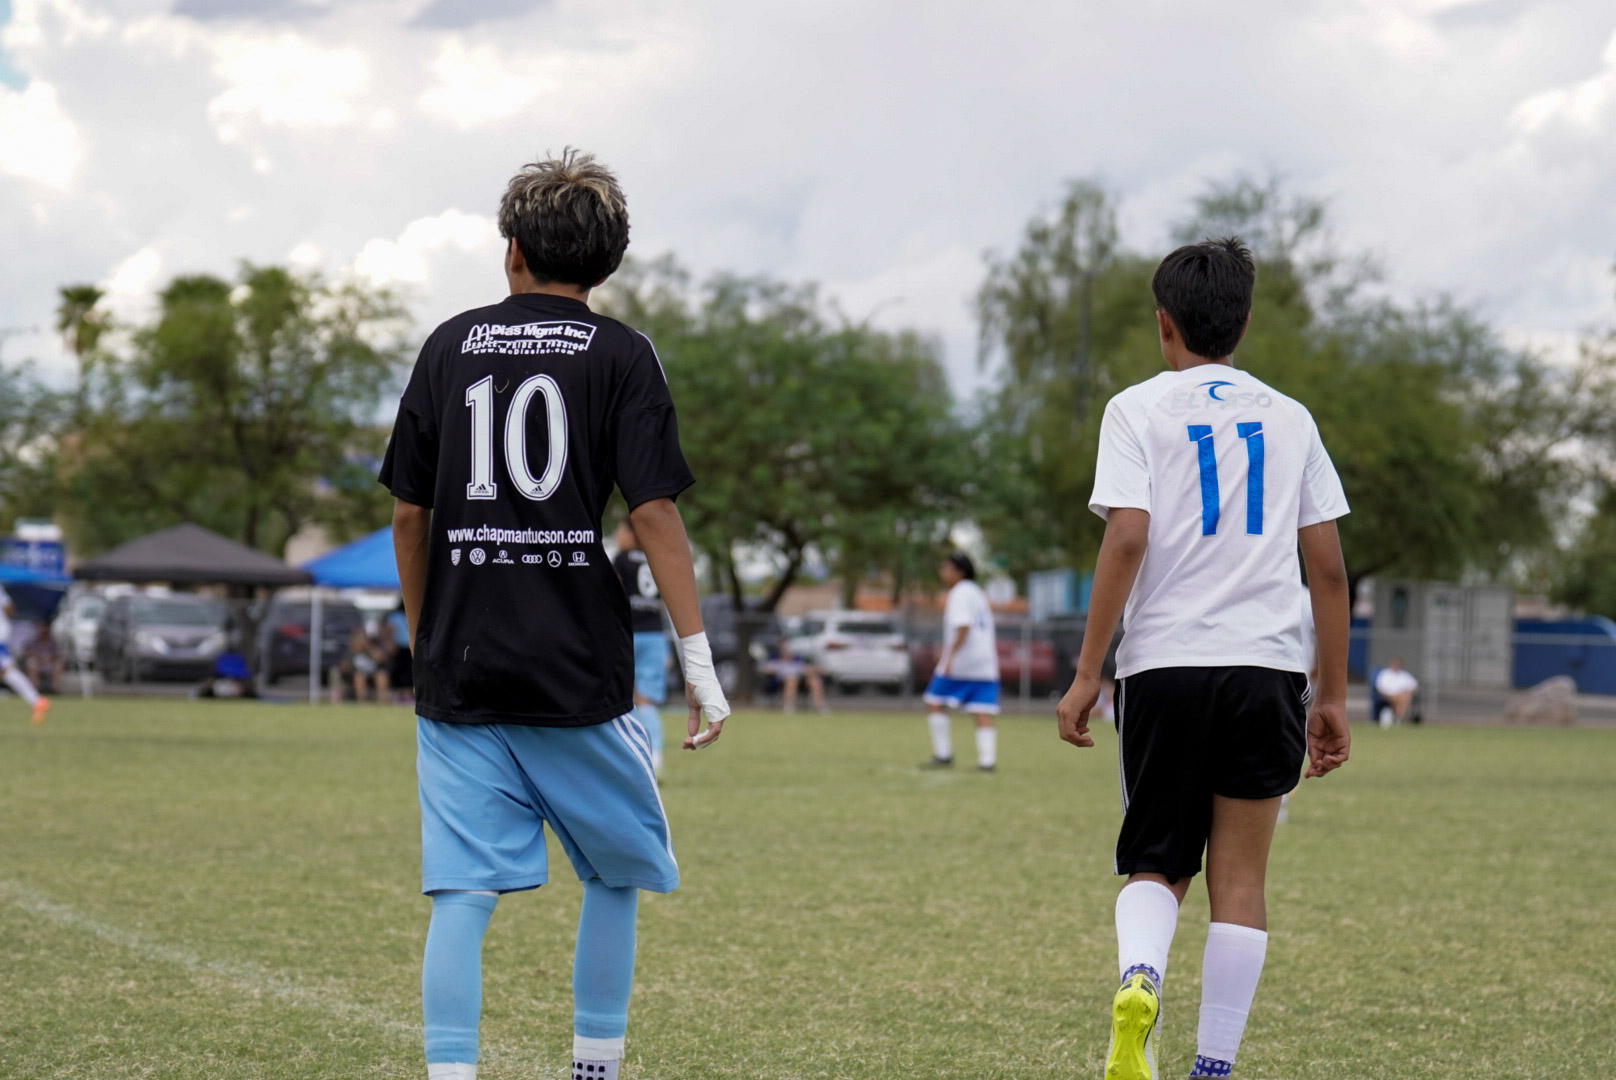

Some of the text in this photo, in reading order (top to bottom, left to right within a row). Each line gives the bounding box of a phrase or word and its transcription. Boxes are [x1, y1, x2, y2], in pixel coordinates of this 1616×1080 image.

[490, 324, 522, 336] Dias
[523, 325, 564, 339] Mgmt
[564, 325, 590, 340] Inc.
[506, 340, 533, 349] PRIDE
[1171, 391, 1200, 410] EL
[465, 373, 568, 501] 10
[1187, 422, 1264, 536] 11
[447, 524, 594, 545] www.chapmantucson.com
